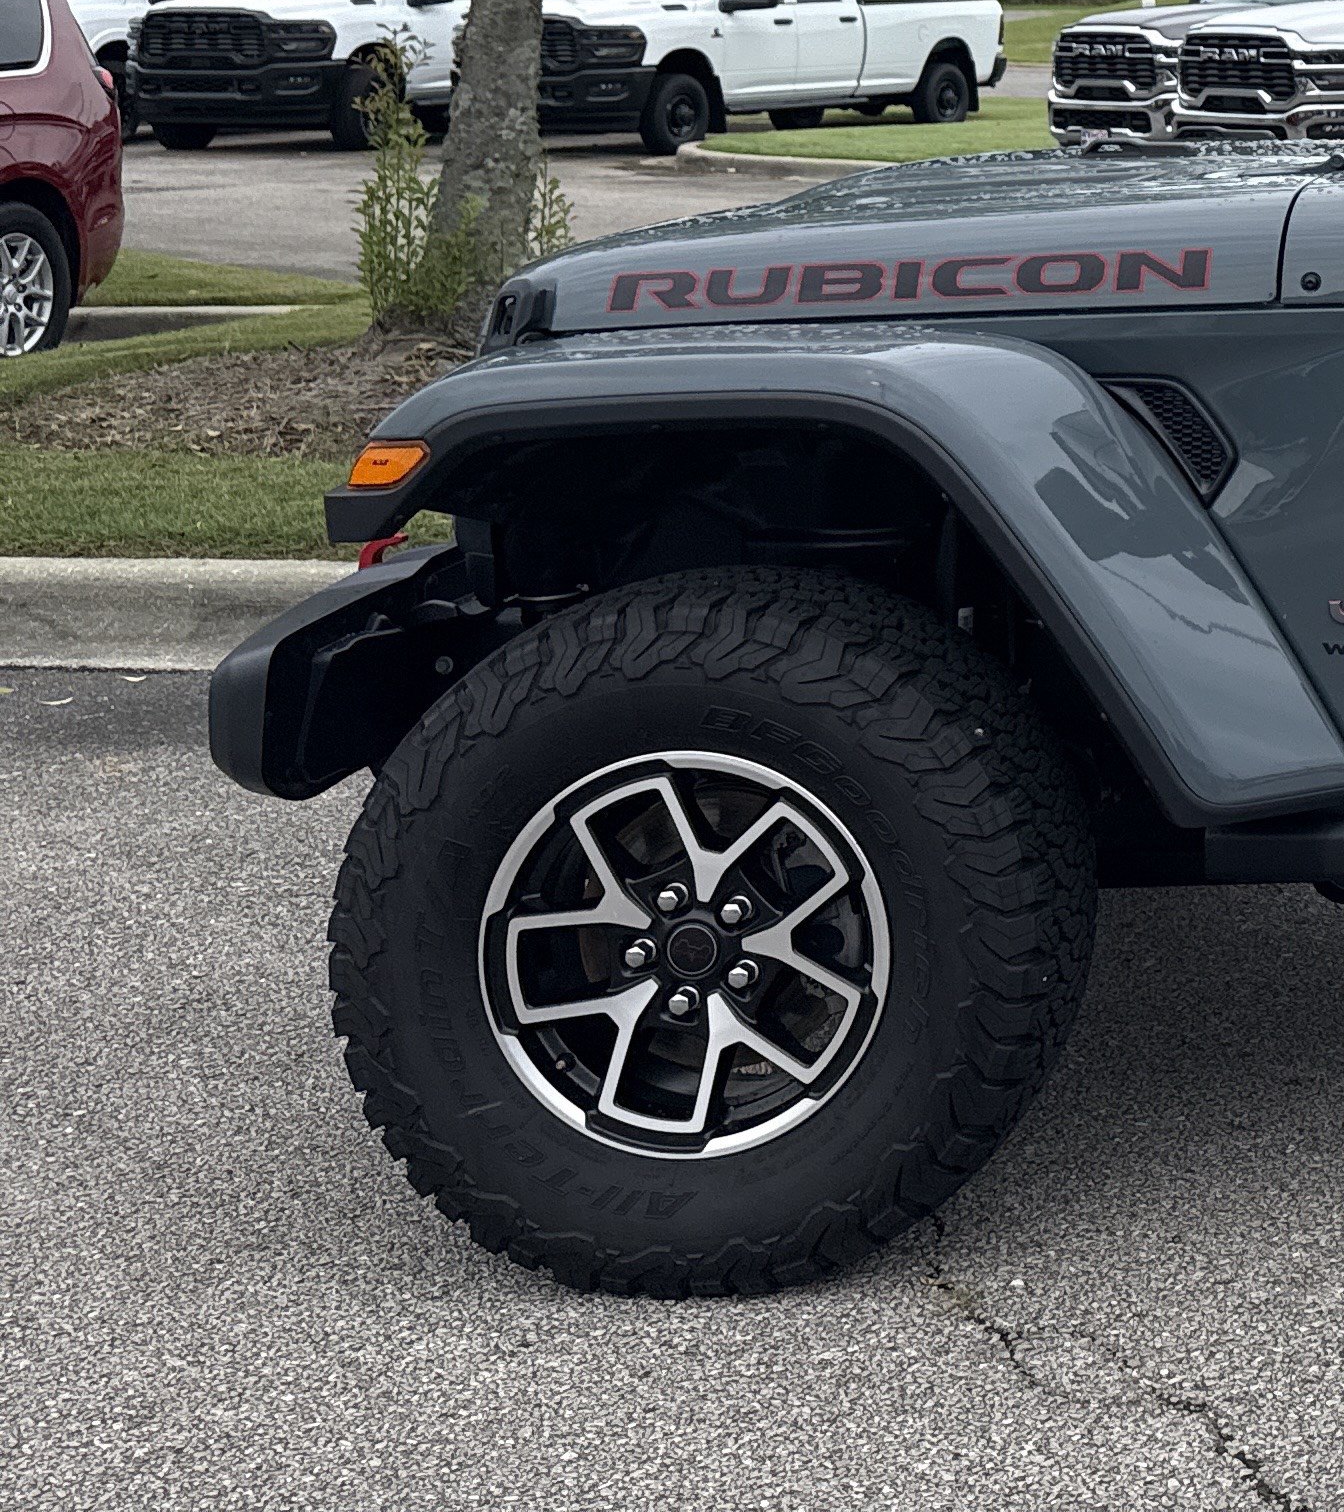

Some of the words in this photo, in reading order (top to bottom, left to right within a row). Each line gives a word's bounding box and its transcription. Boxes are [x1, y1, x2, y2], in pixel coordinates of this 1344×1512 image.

[1072, 43, 1124, 57] RAM
[1199, 47, 1258, 61] RAM
[606, 248, 1213, 313] RUBICON
